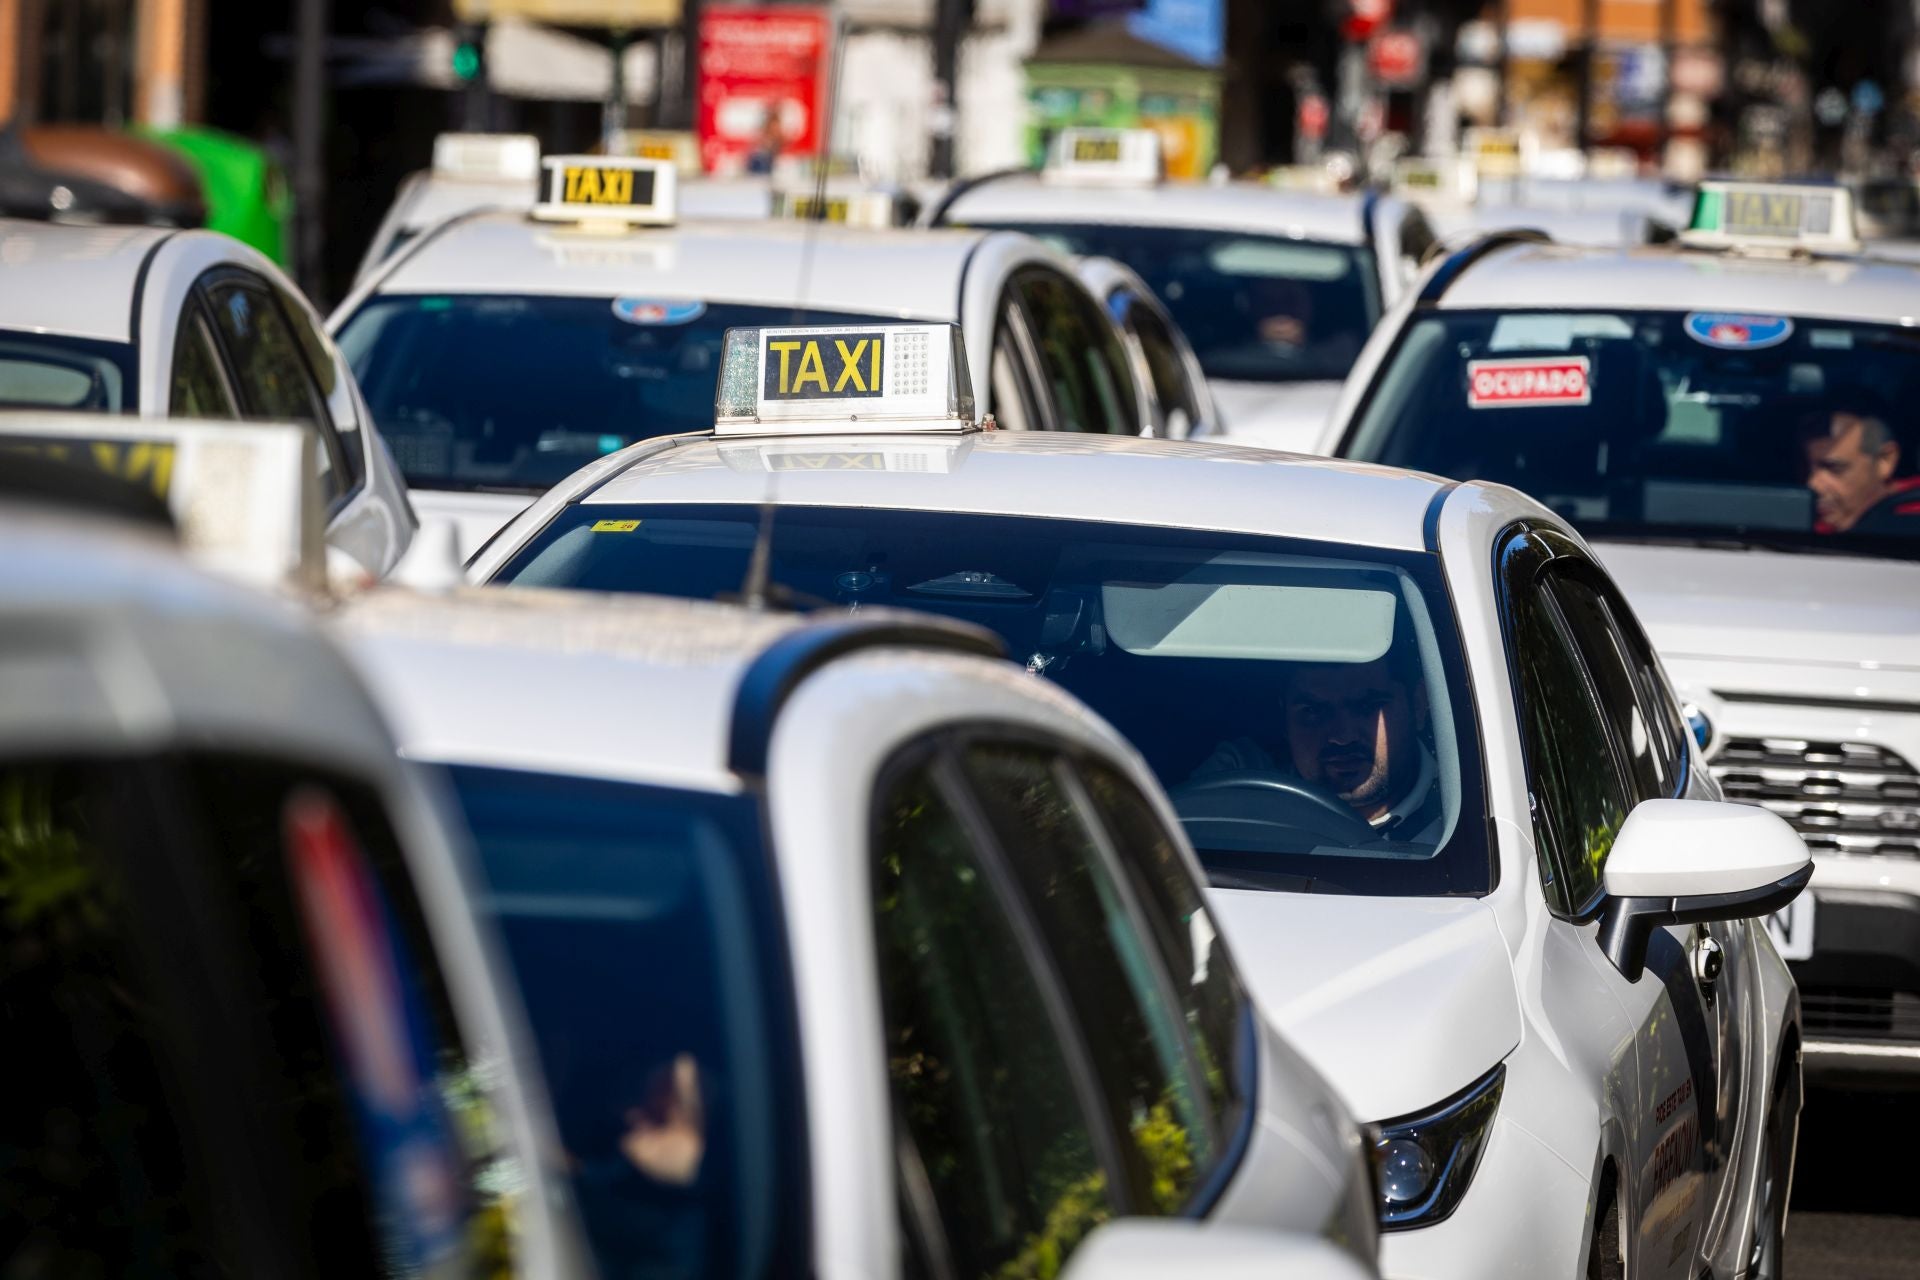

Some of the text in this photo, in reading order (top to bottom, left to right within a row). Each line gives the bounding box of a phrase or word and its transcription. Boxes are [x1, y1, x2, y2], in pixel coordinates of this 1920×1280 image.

[564, 167, 633, 203] TAXI
[1733, 192, 1799, 226] TAXI
[769, 339, 881, 394] TAXI
[1474, 368, 1584, 396] OCUPADO
